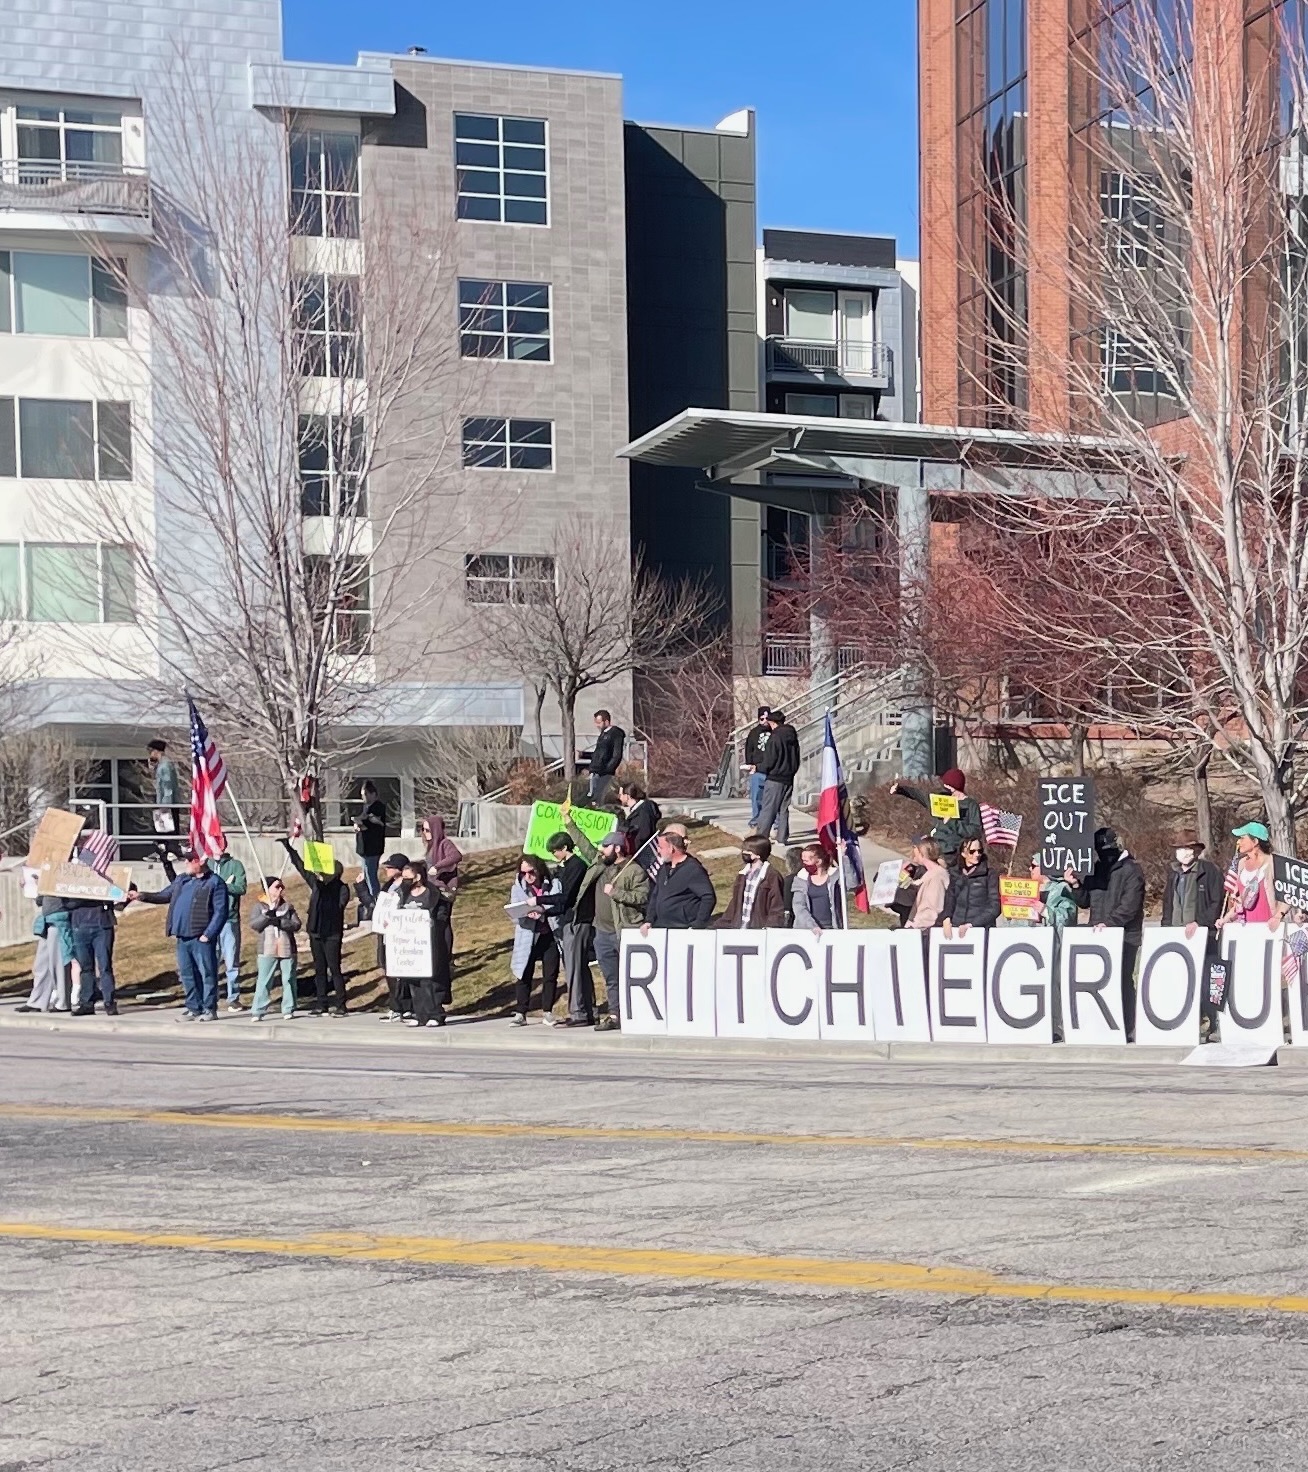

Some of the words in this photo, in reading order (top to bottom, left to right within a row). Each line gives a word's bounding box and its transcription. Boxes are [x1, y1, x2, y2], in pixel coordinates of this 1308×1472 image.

[1041, 783, 1085, 806] ICE
[1043, 810, 1088, 834] OUT
[1042, 846, 1092, 873] UTAH
[1274, 879, 1298, 896] OUT
